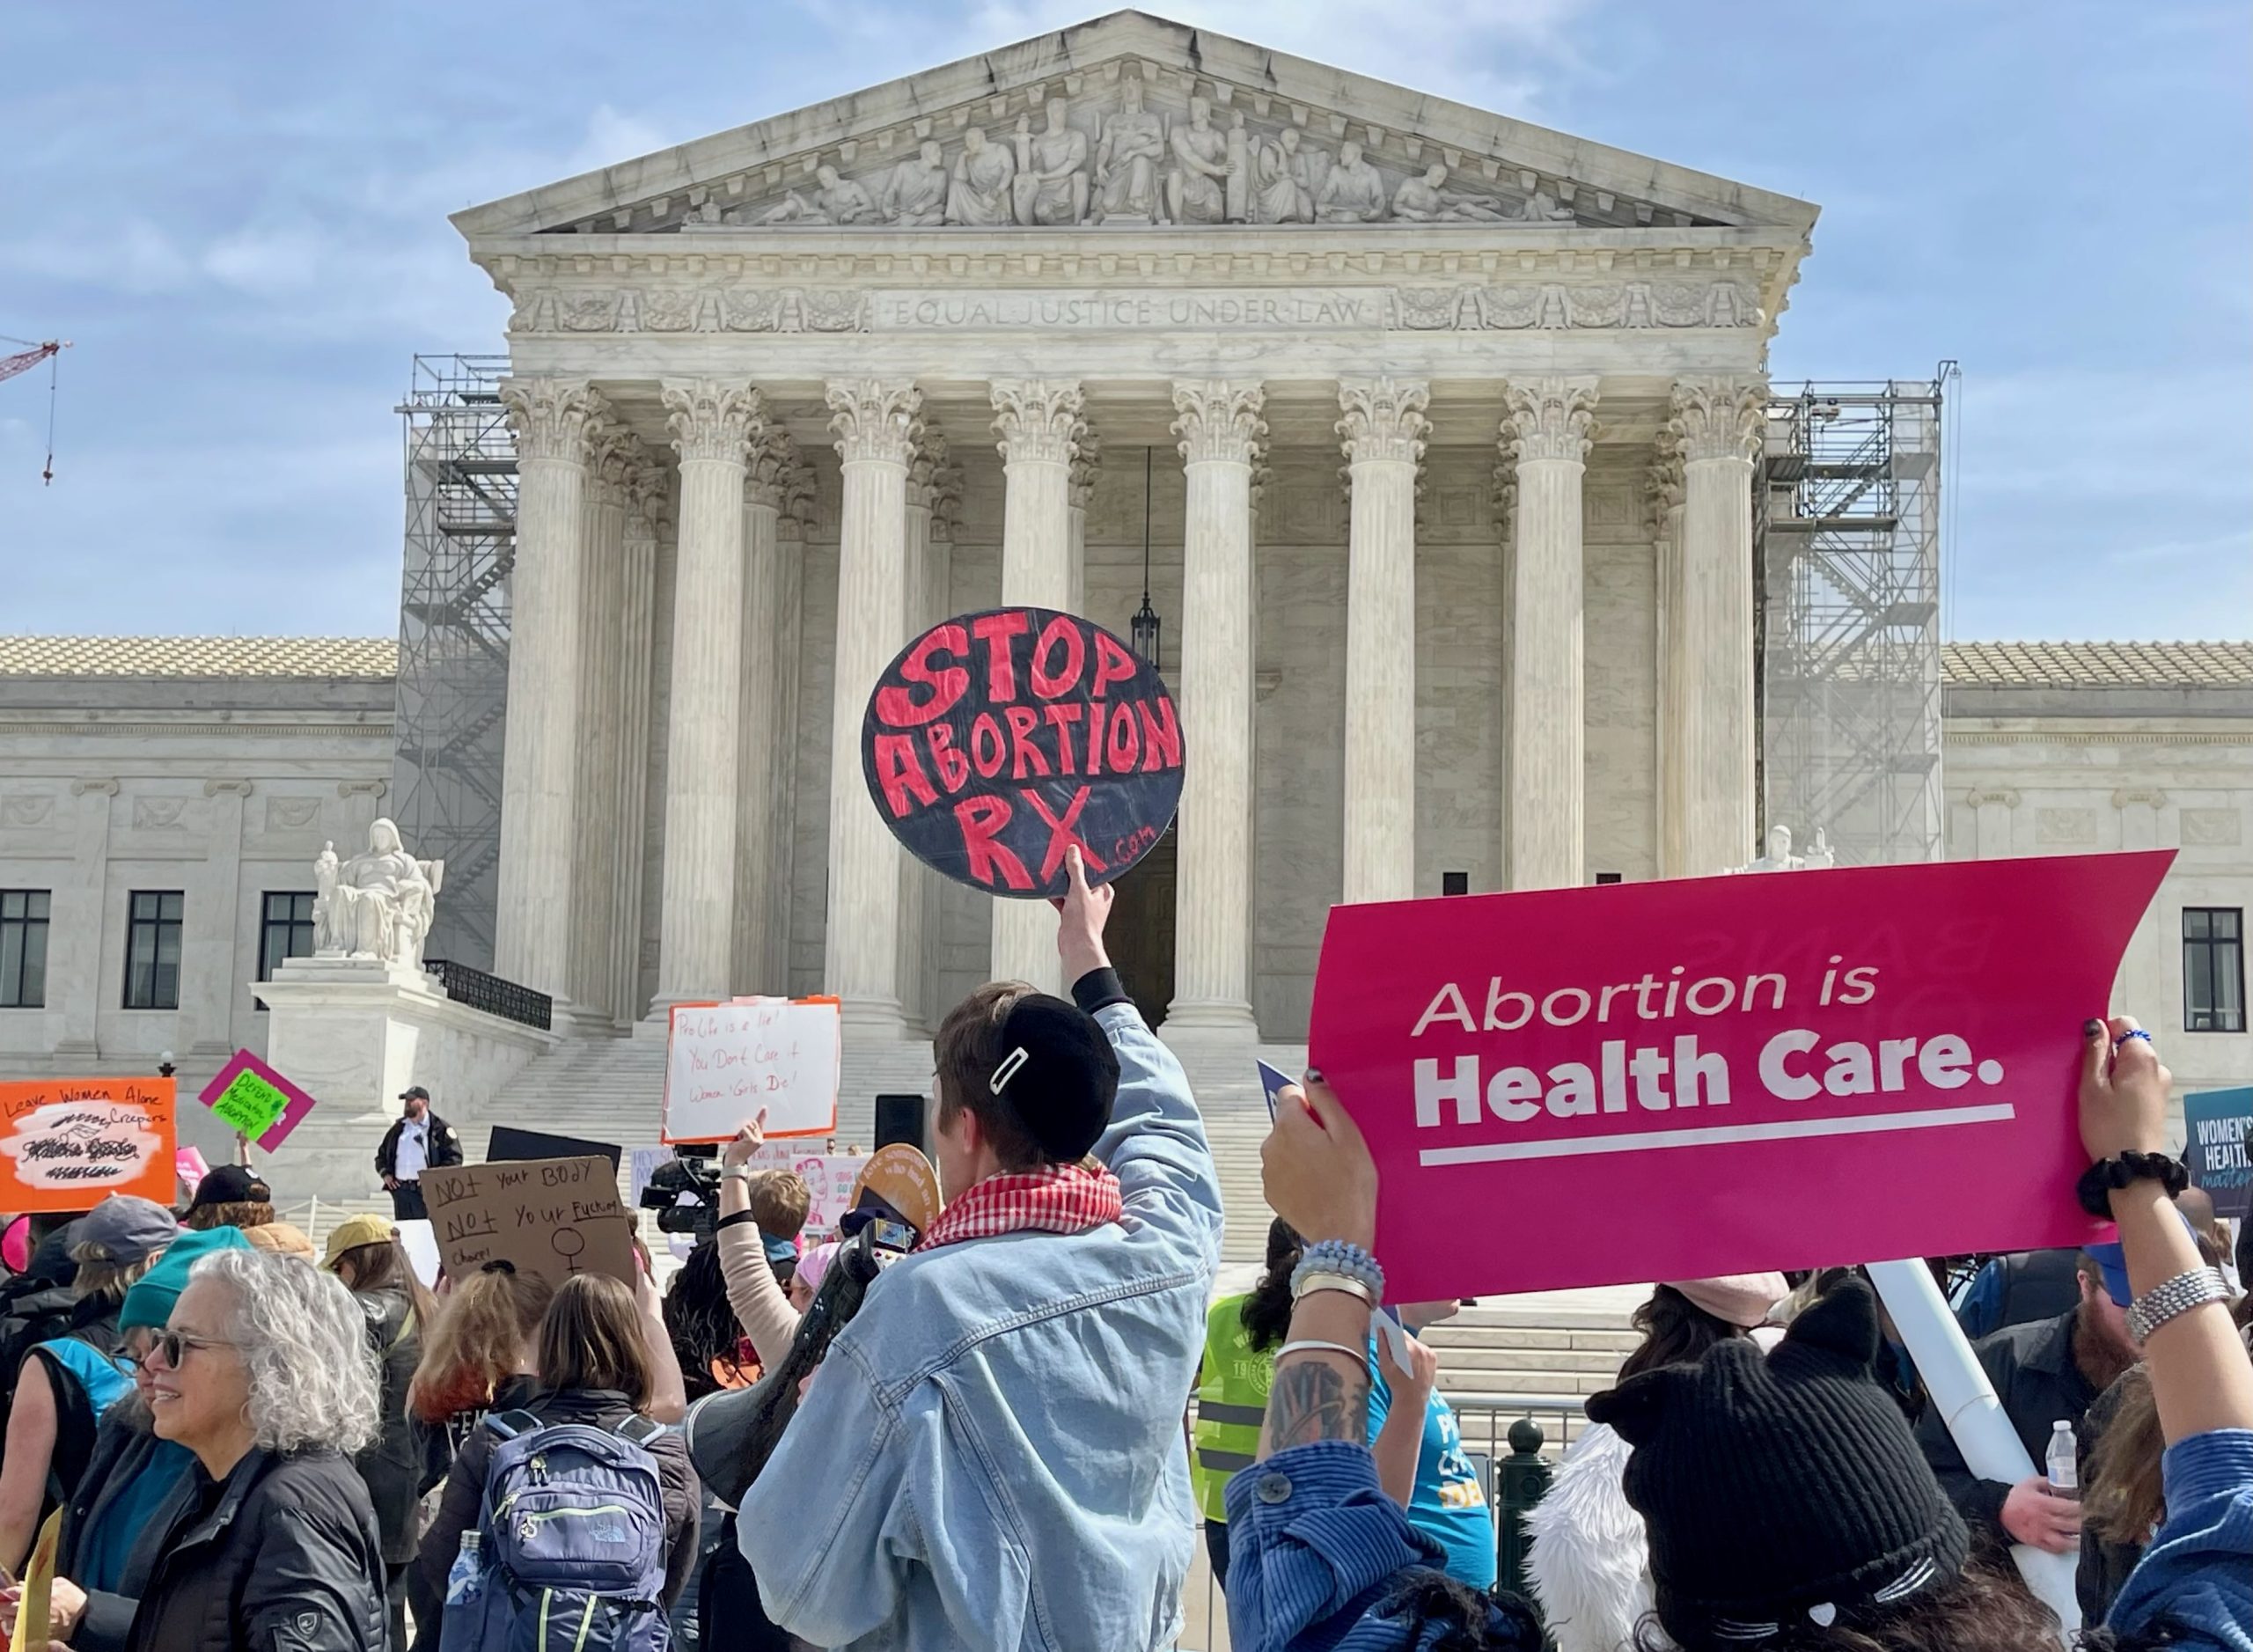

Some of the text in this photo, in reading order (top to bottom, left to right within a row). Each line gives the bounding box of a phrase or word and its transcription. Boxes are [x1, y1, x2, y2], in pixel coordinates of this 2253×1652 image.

[895, 298, 1366, 327] EQUAL JUSTICE UNDER LAW
[875, 612, 1137, 728] STOP
[874, 696, 1182, 819] ABORTION
[954, 786, 1109, 891] RX
[1410, 965, 1787, 1039] Abortion
[1818, 954, 1880, 1007] is
[4, 1085, 163, 1118] Leave Women Alone
[689, 1048, 708, 1072] You
[754, 1043, 779, 1064] Care
[1413, 1028, 2005, 1127] Health Care.
